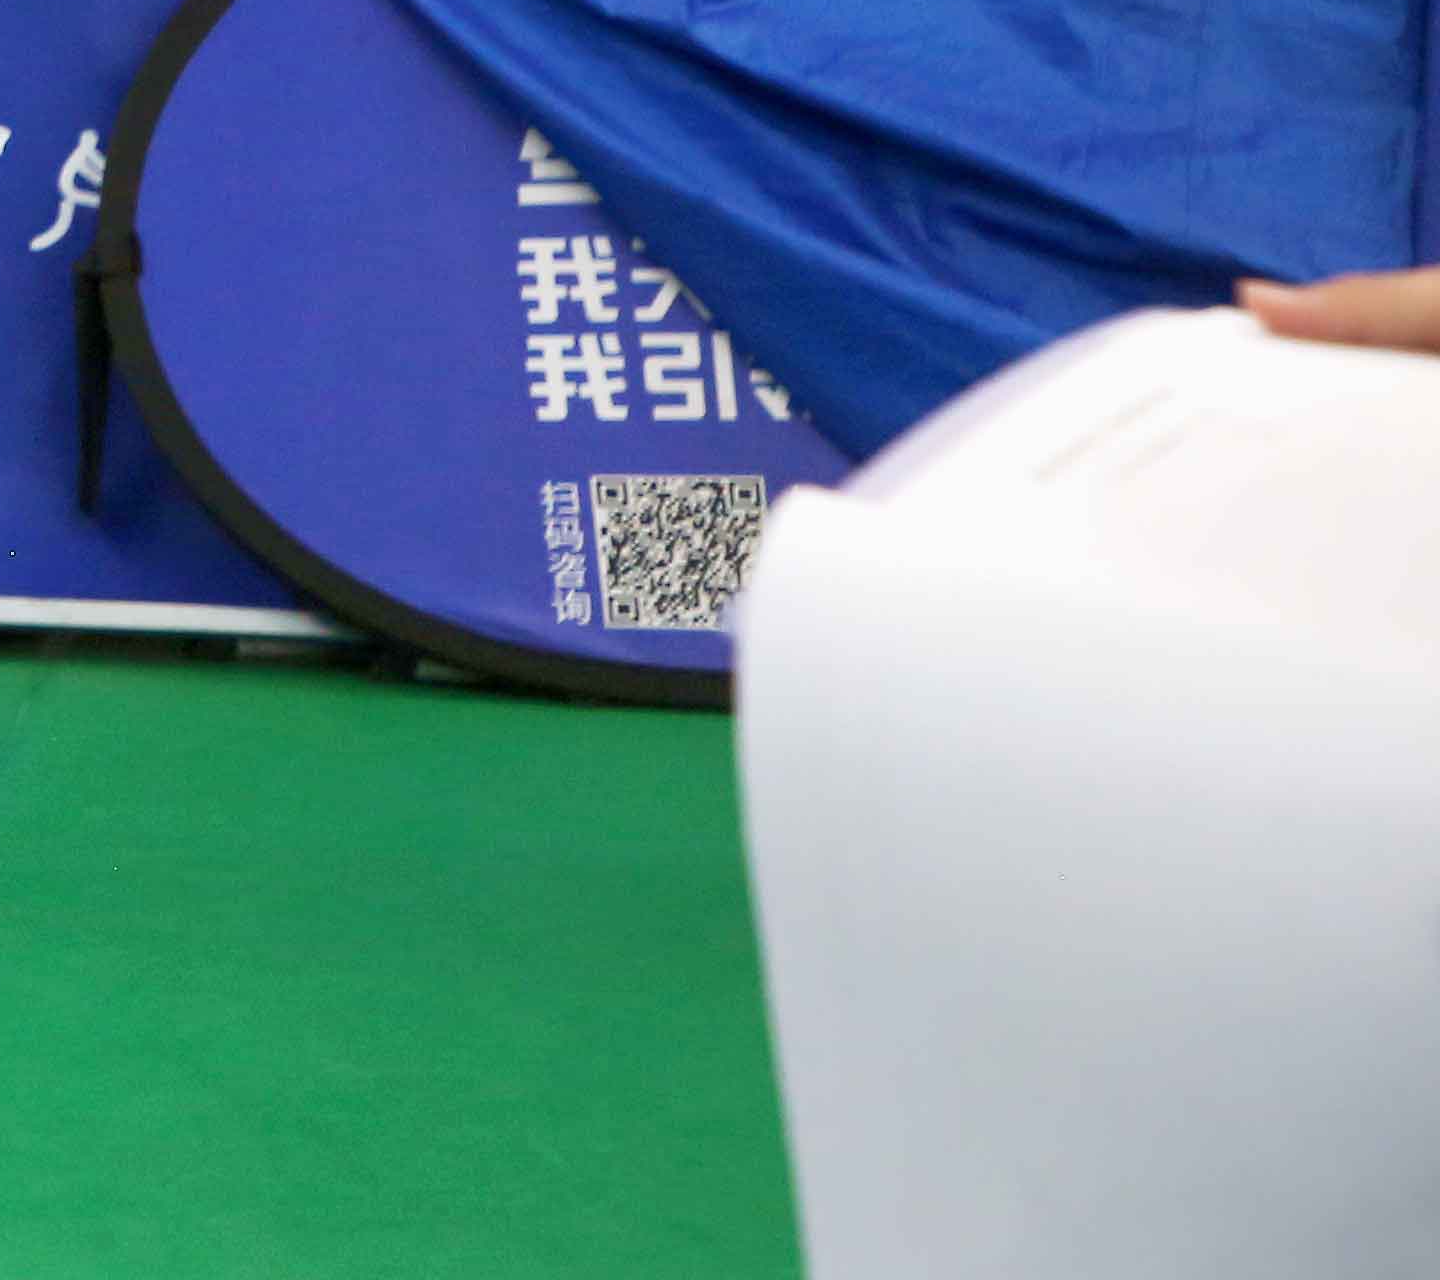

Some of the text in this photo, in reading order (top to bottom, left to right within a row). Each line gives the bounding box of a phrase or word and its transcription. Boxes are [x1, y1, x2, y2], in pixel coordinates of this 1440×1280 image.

[525, 331, 792, 423] 我引
[539, 479, 592, 626] 扫码咨询
